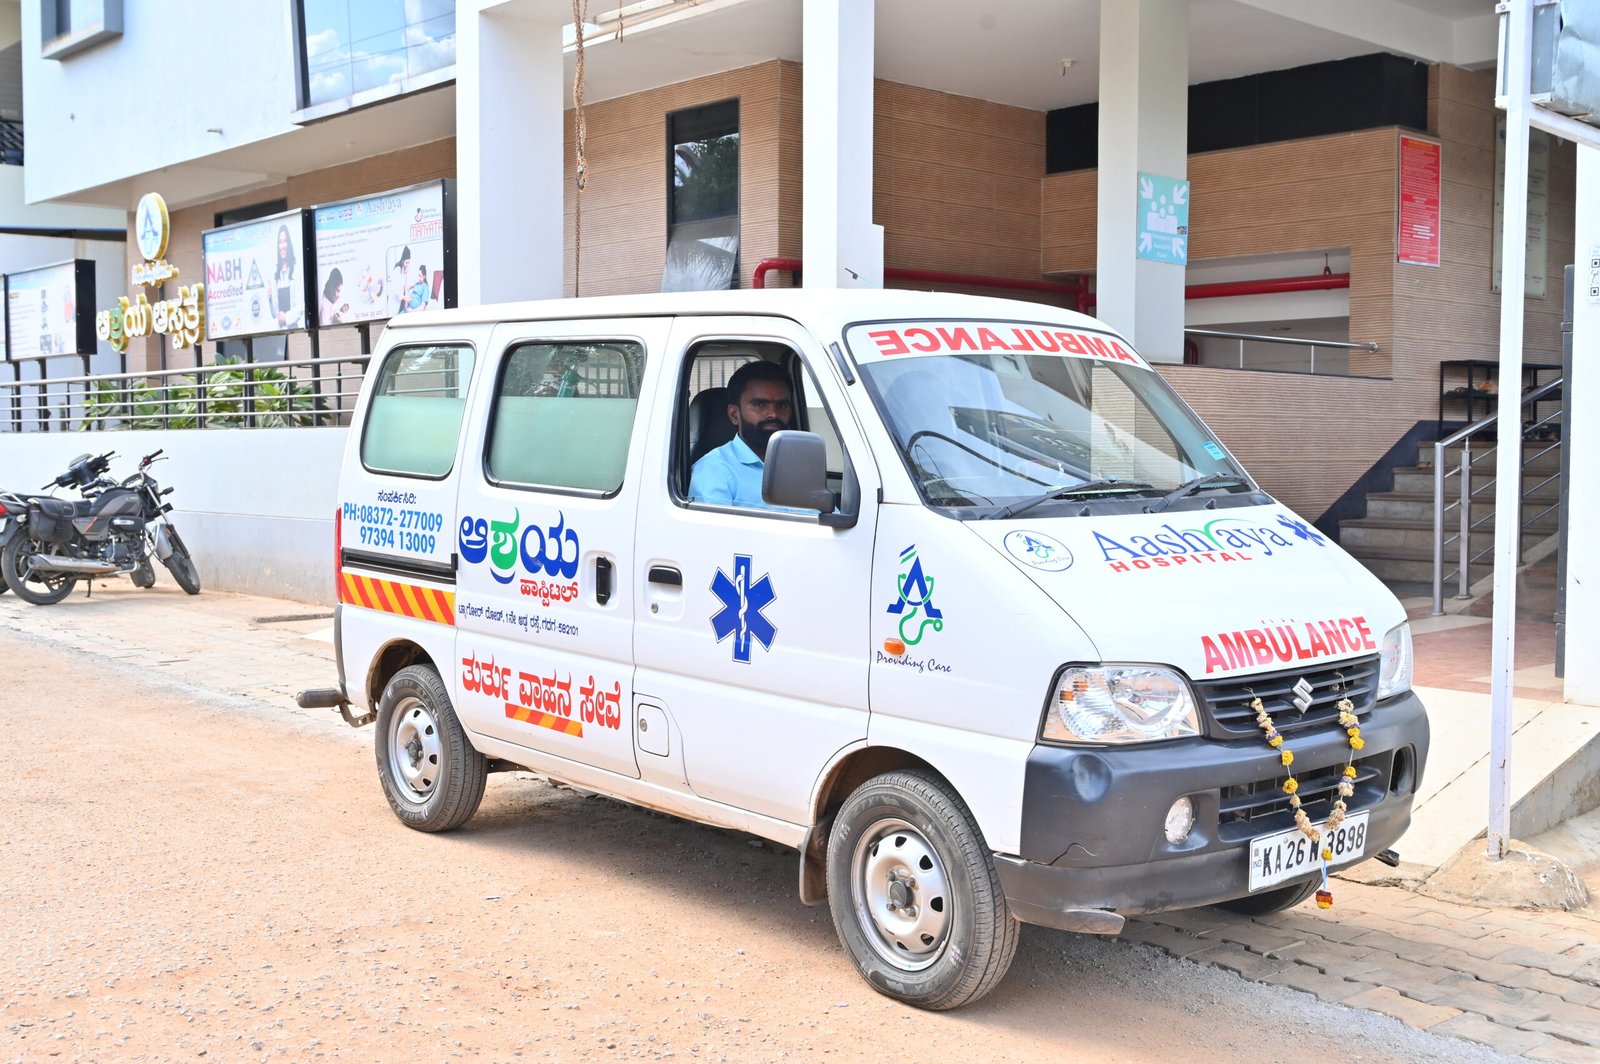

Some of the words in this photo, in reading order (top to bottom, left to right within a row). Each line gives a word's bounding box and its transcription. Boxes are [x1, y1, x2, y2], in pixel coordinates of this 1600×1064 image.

[207, 258, 242, 285] NABH
[207, 283, 244, 301] Accredited
[96, 293, 149, 352] ಆಶ್ರಯ
[360, 525, 394, 548] 97394
[399, 531, 436, 554] 13009
[1091, 518, 1293, 561] Aashraya
[1109, 551, 1253, 573] HOSPITAL
[519, 579, 579, 607] ಹಾಸ್ಪಿಟಲ್
[1201, 616, 1376, 674] AMBULANCE
[876, 650, 924, 674] Providing
[927, 658, 952, 673] Care
[462, 649, 512, 701] ತುರ್ತು
[519, 668, 572, 717] ವಾಹನ
[580, 674, 621, 731] ಸೇವೆ
[1326, 822, 1365, 856] 3898
